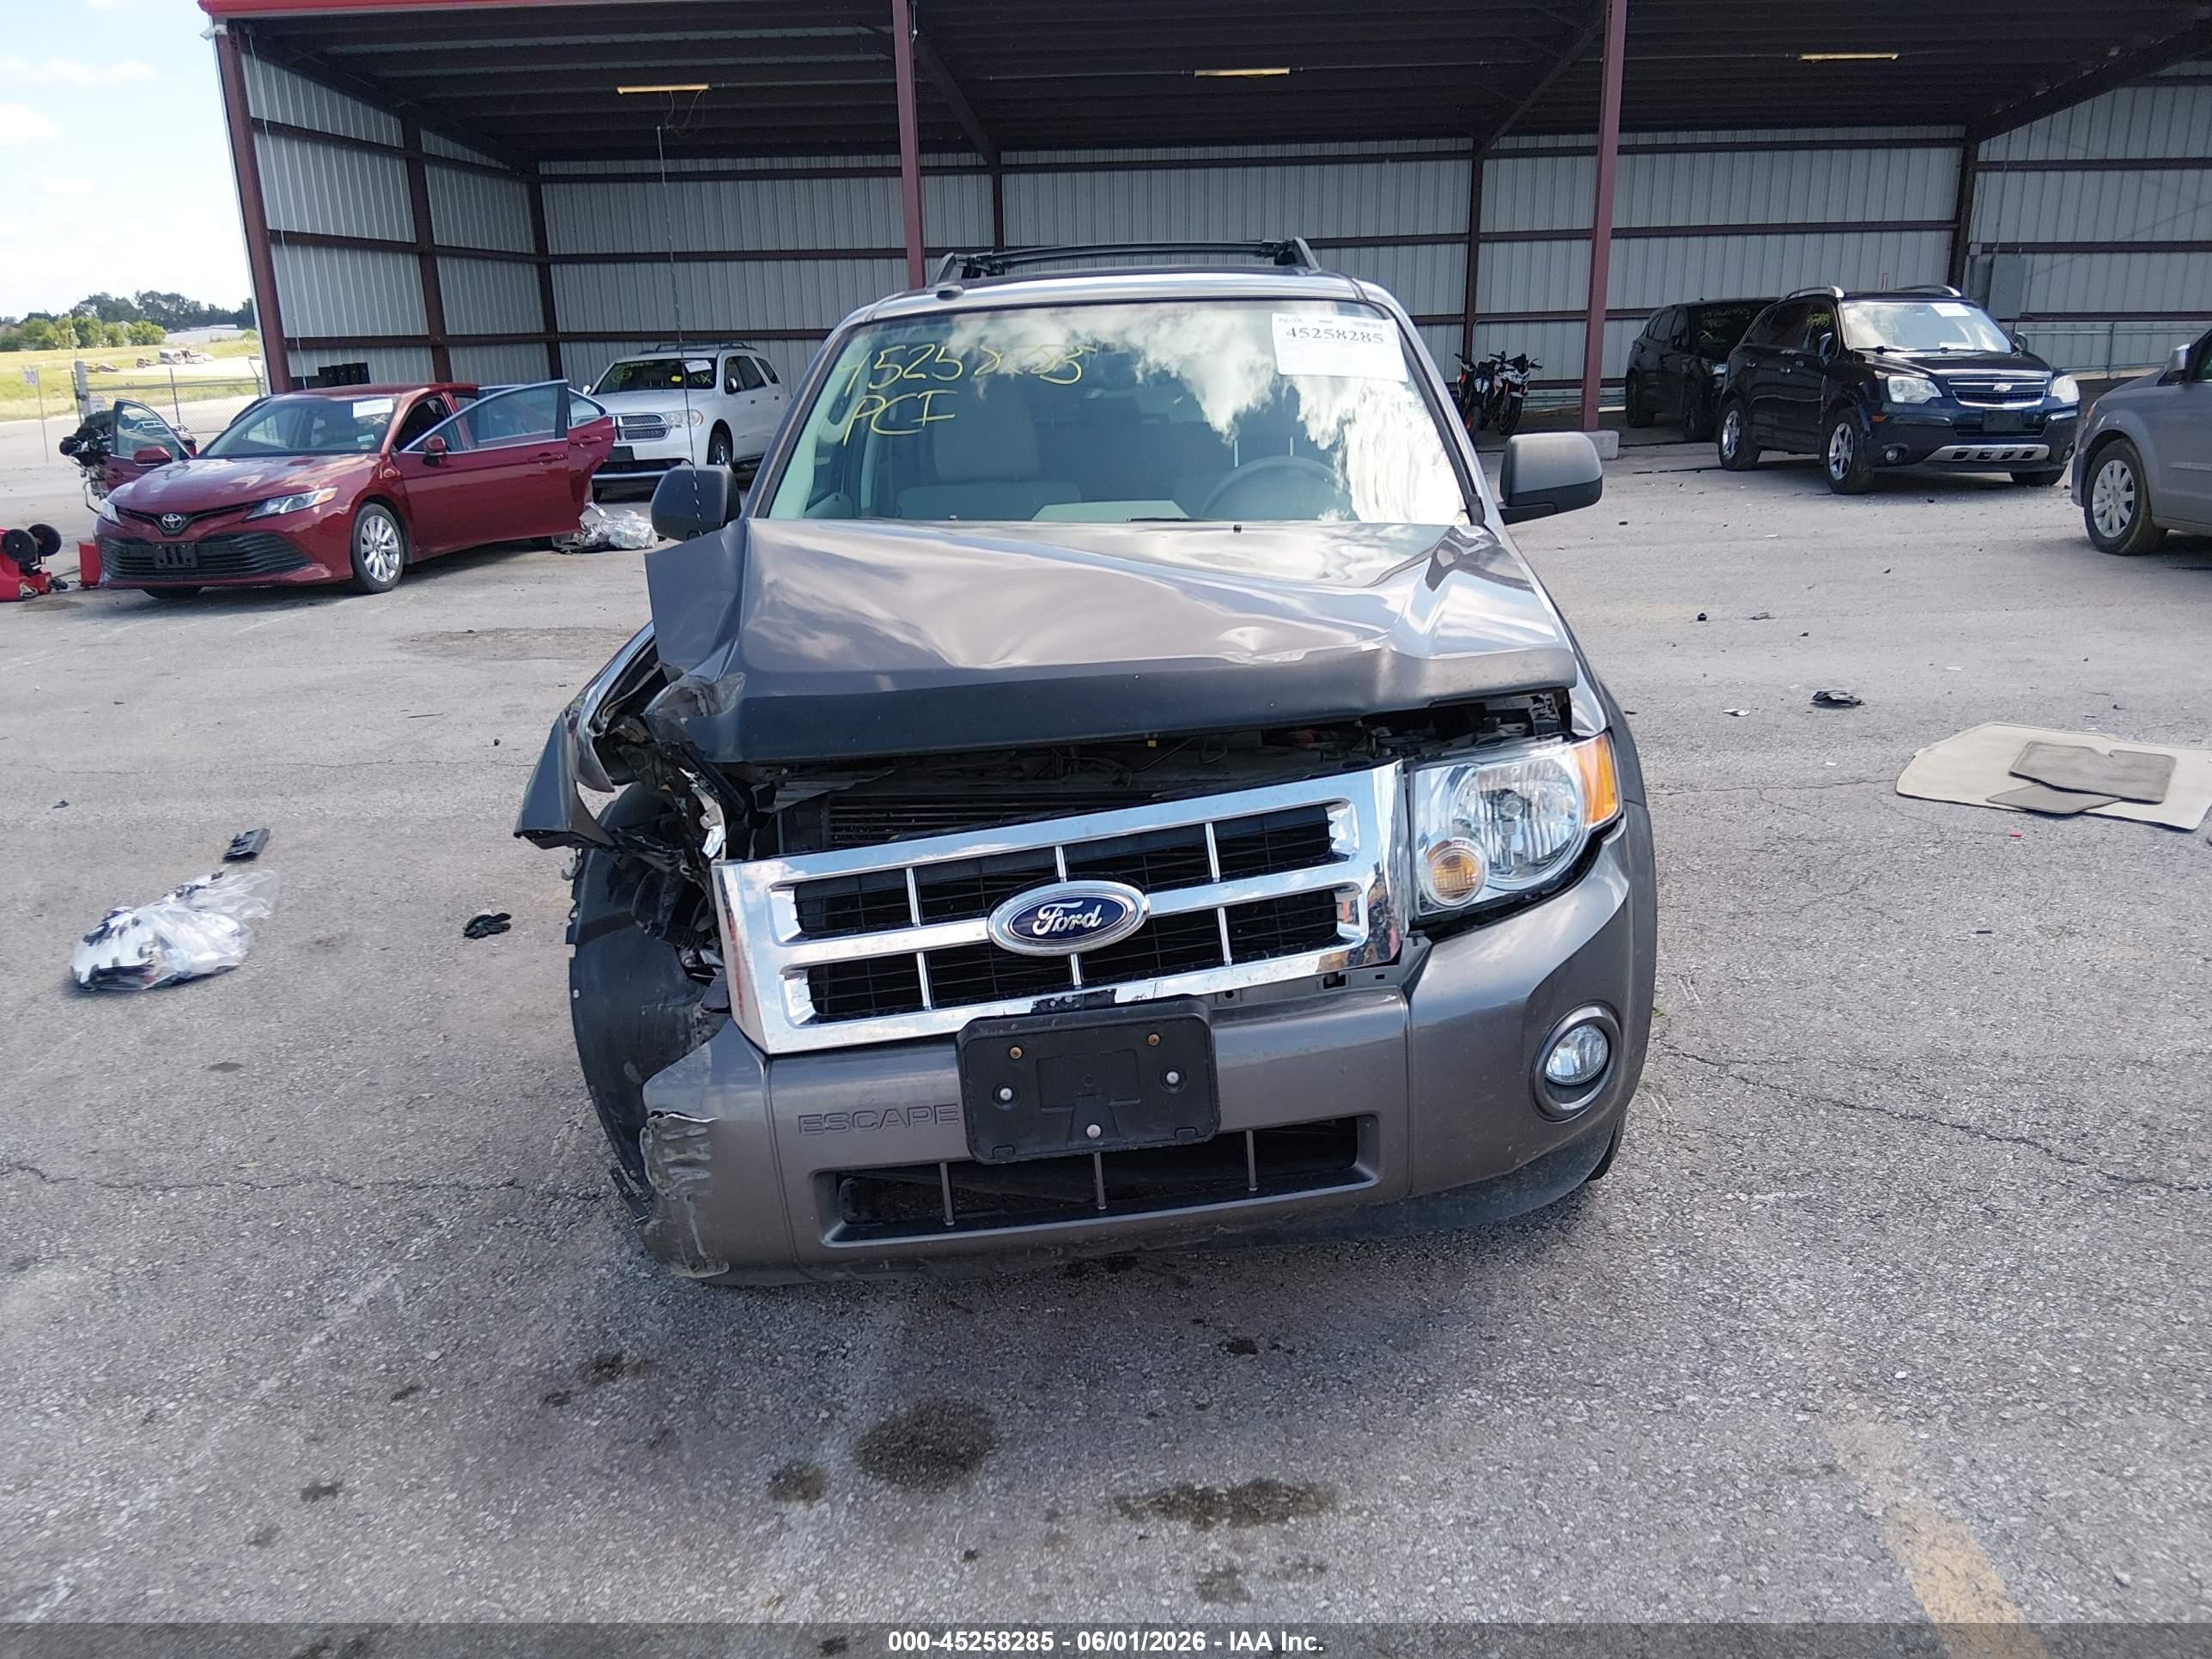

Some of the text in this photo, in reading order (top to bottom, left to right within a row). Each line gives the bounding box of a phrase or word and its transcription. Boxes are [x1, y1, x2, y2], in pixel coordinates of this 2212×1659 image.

[1285, 327, 1384, 343] 45258285
[1032, 901, 1103, 935] Ford
[797, 1103, 960, 1136] ESCAPE
